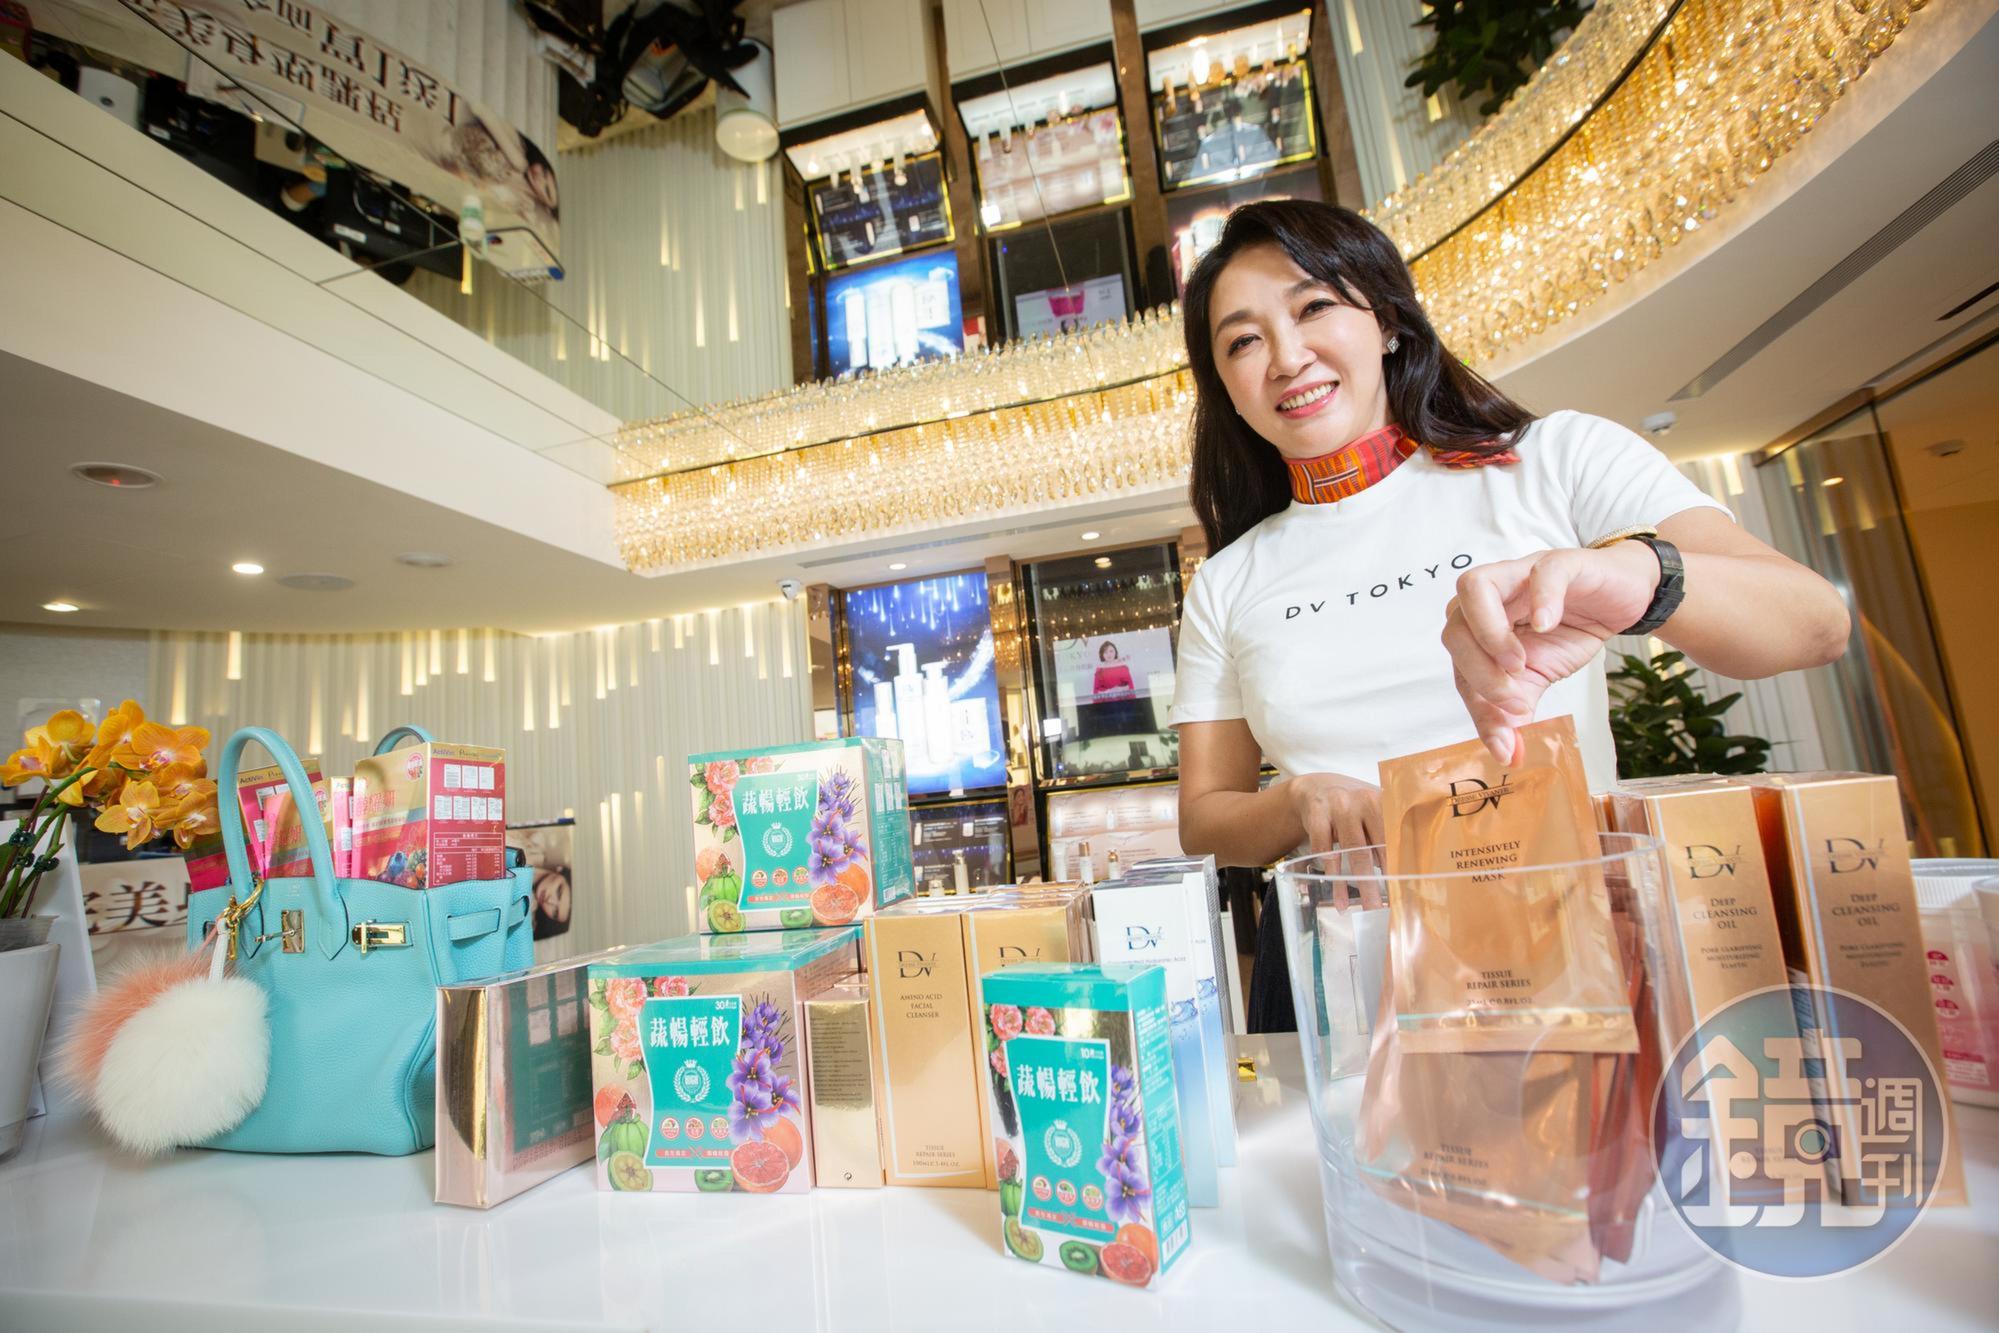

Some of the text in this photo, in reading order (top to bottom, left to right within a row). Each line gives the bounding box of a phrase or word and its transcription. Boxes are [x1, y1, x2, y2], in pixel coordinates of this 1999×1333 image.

[1285, 553, 1473, 620] DV TOKYO
[741, 785, 810, 815] 蔬暢輕飲
[1450, 840, 1521, 859] INTENSIVELY
[1456, 853, 1518, 870] RENEWING
[1471, 871, 1506, 884] MASK
[1692, 906, 1758, 920] CLEANSING
[1831, 903, 1901, 917] CLEANSING
[1717, 919, 1738, 929] OIL
[1857, 916, 1880, 927] OIL
[1482, 969, 1513, 980] TISSUE
[1466, 979, 1531, 990] REPAIR SERIES
[910, 1002, 934, 1010] FACIAL
[906, 1011, 940, 1019] CLEANSER
[650, 1016, 730, 1049] 蔬暢輕飲
[1015, 1064, 1102, 1106] 蔬暢輕飲
